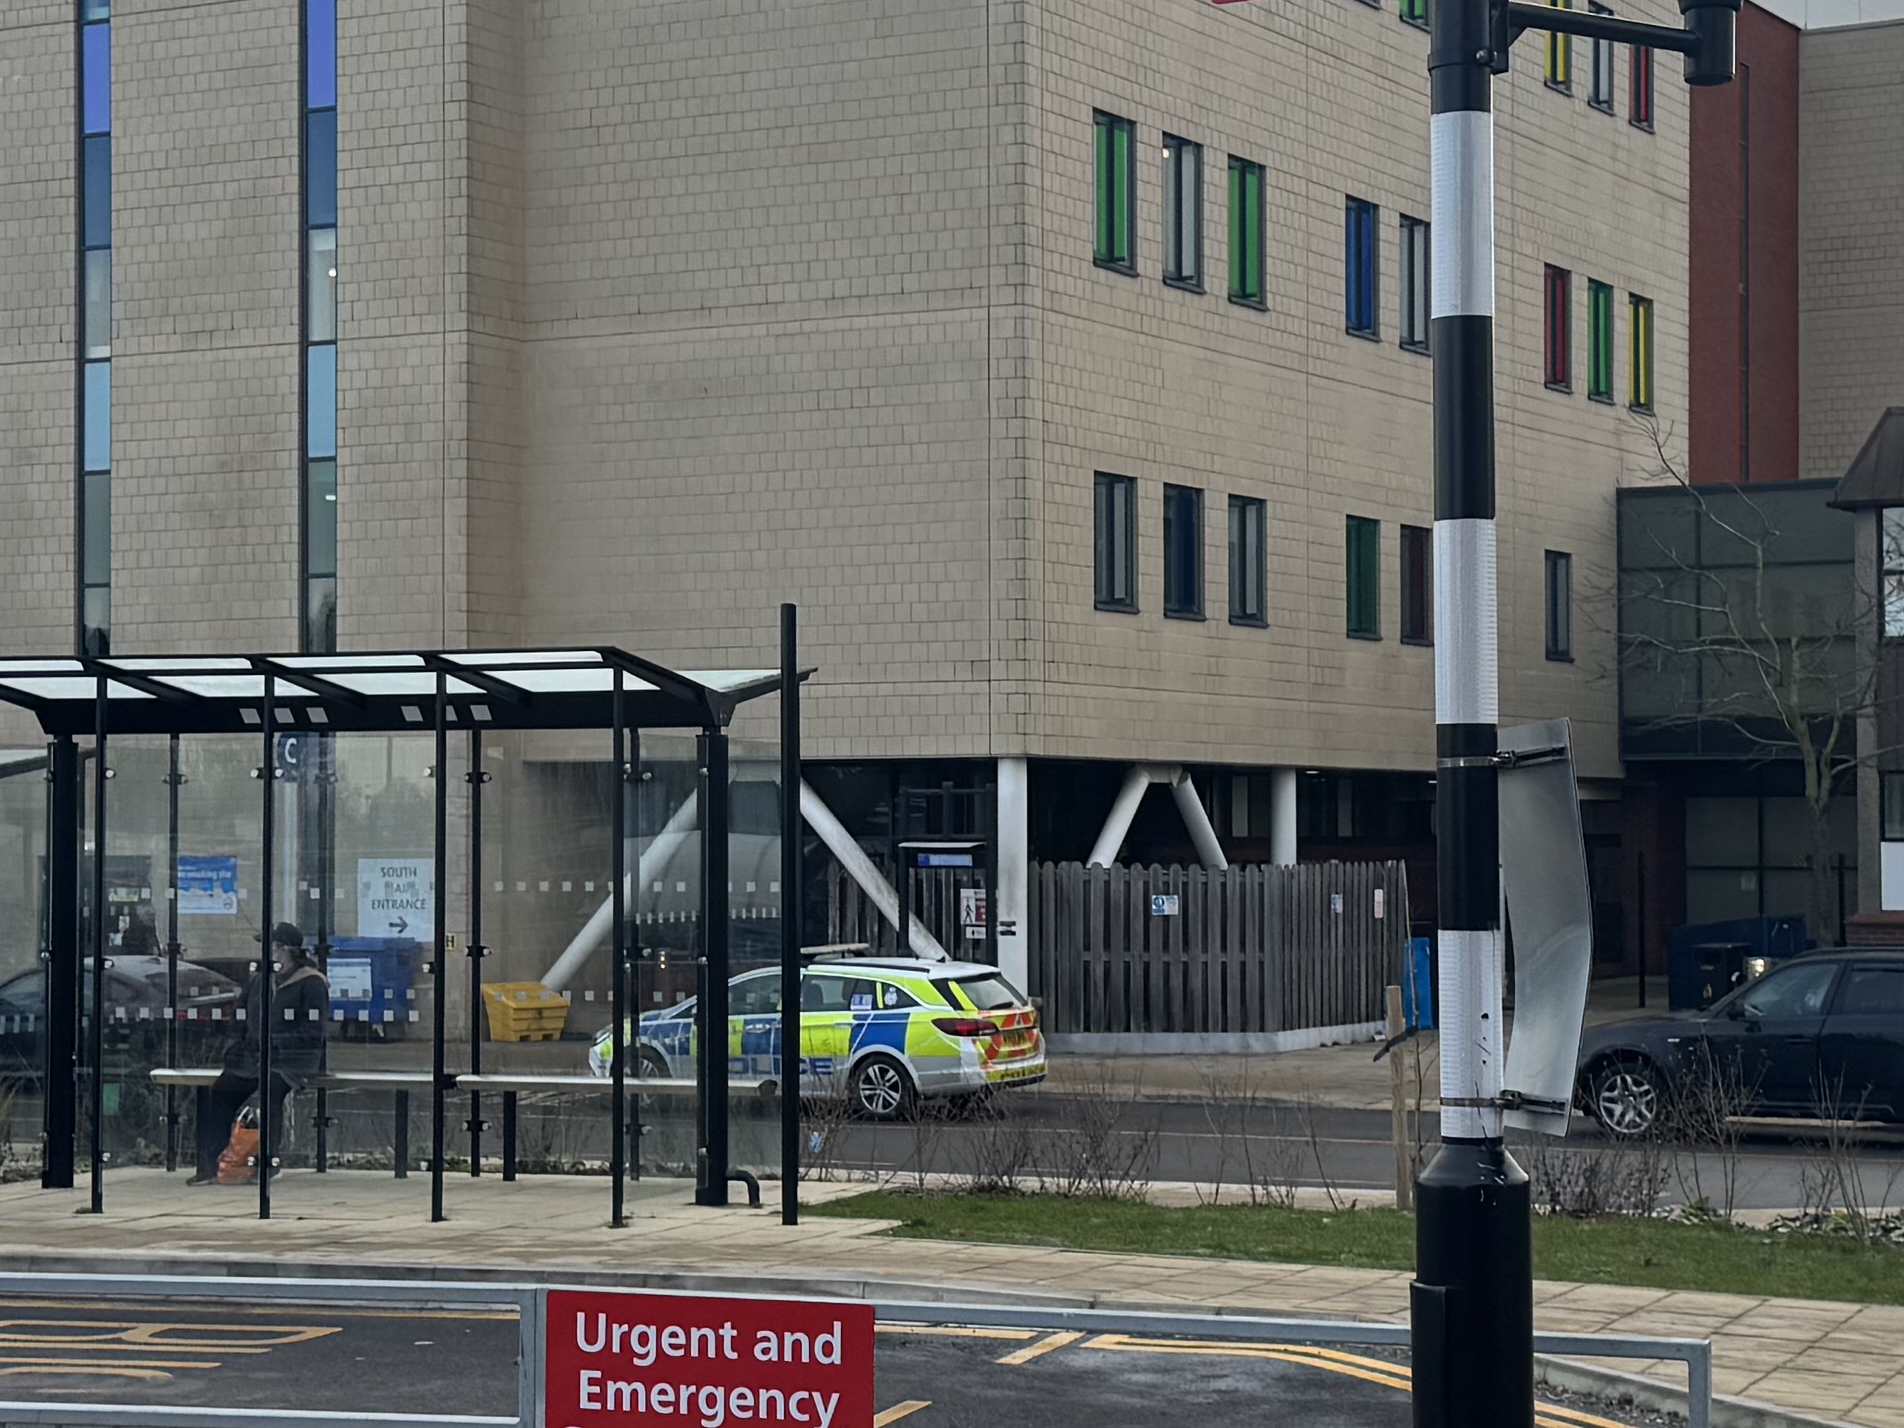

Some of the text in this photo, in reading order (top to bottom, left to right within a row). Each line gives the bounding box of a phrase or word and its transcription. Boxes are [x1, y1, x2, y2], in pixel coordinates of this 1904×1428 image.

[285, 738, 297, 763] C
[380, 866, 417, 878] SOUTH
[372, 898, 427, 910] ENTRANCE
[576, 1311, 841, 1366] Urgent and
